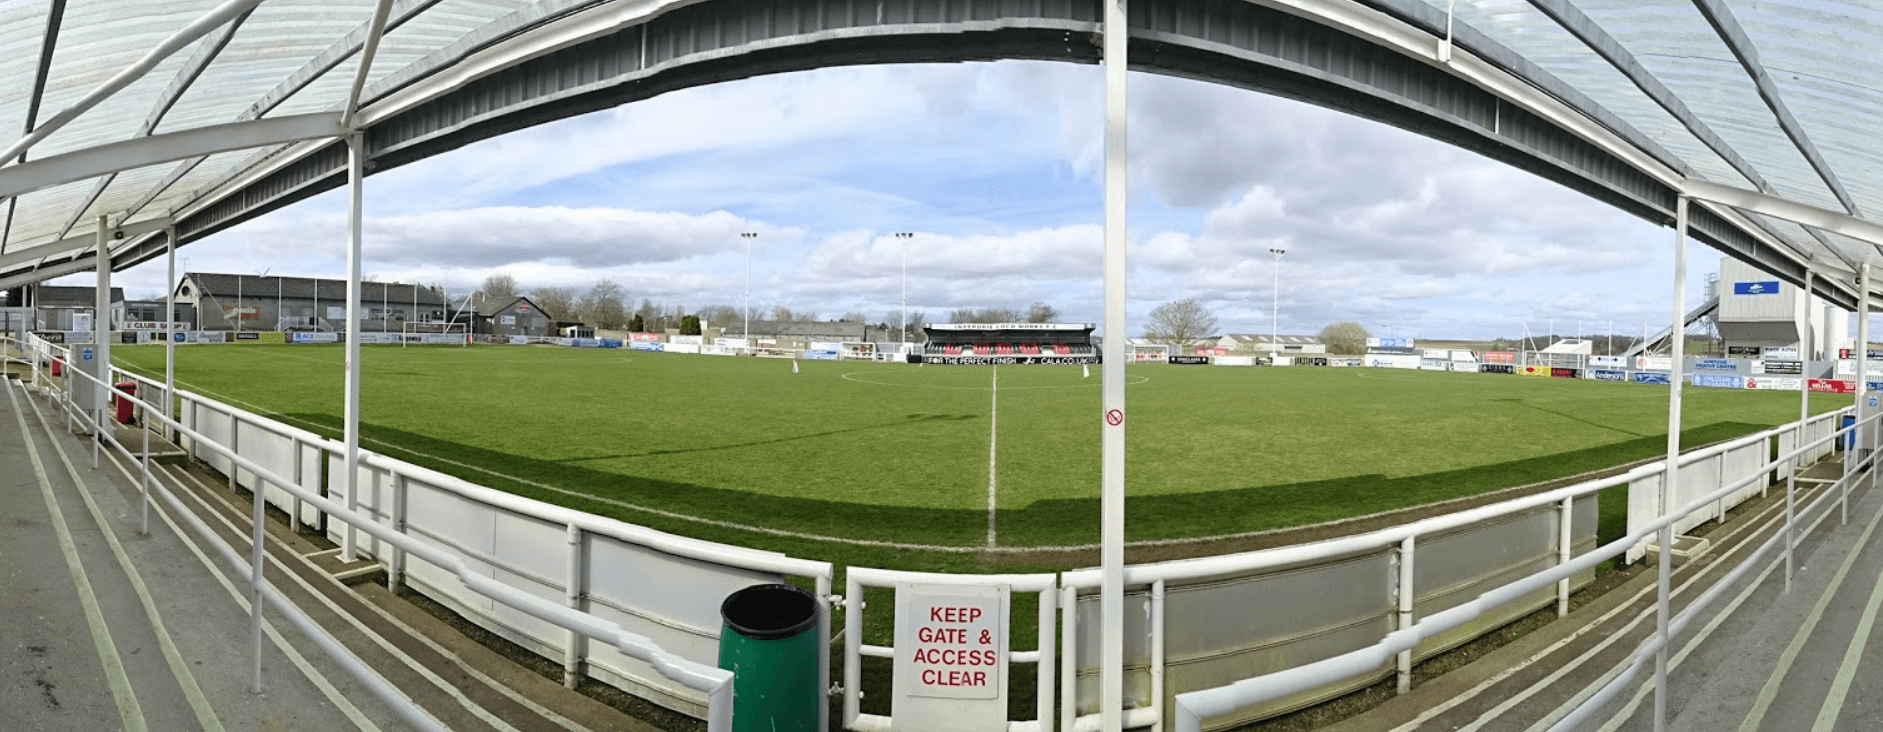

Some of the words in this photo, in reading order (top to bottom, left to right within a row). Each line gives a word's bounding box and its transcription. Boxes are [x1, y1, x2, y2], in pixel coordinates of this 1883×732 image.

[929, 357, 943, 365] FOR
[945, 357, 958, 365] THE
[960, 357, 991, 365] PERFECT
[993, 357, 1017, 365] FINISH
[930, 606, 982, 623] KEEP
[918, 627, 967, 644] GATE
[978, 629, 991, 645] &
[913, 648, 996, 666] ACCESS
[921, 669, 986, 686] CLEAR
